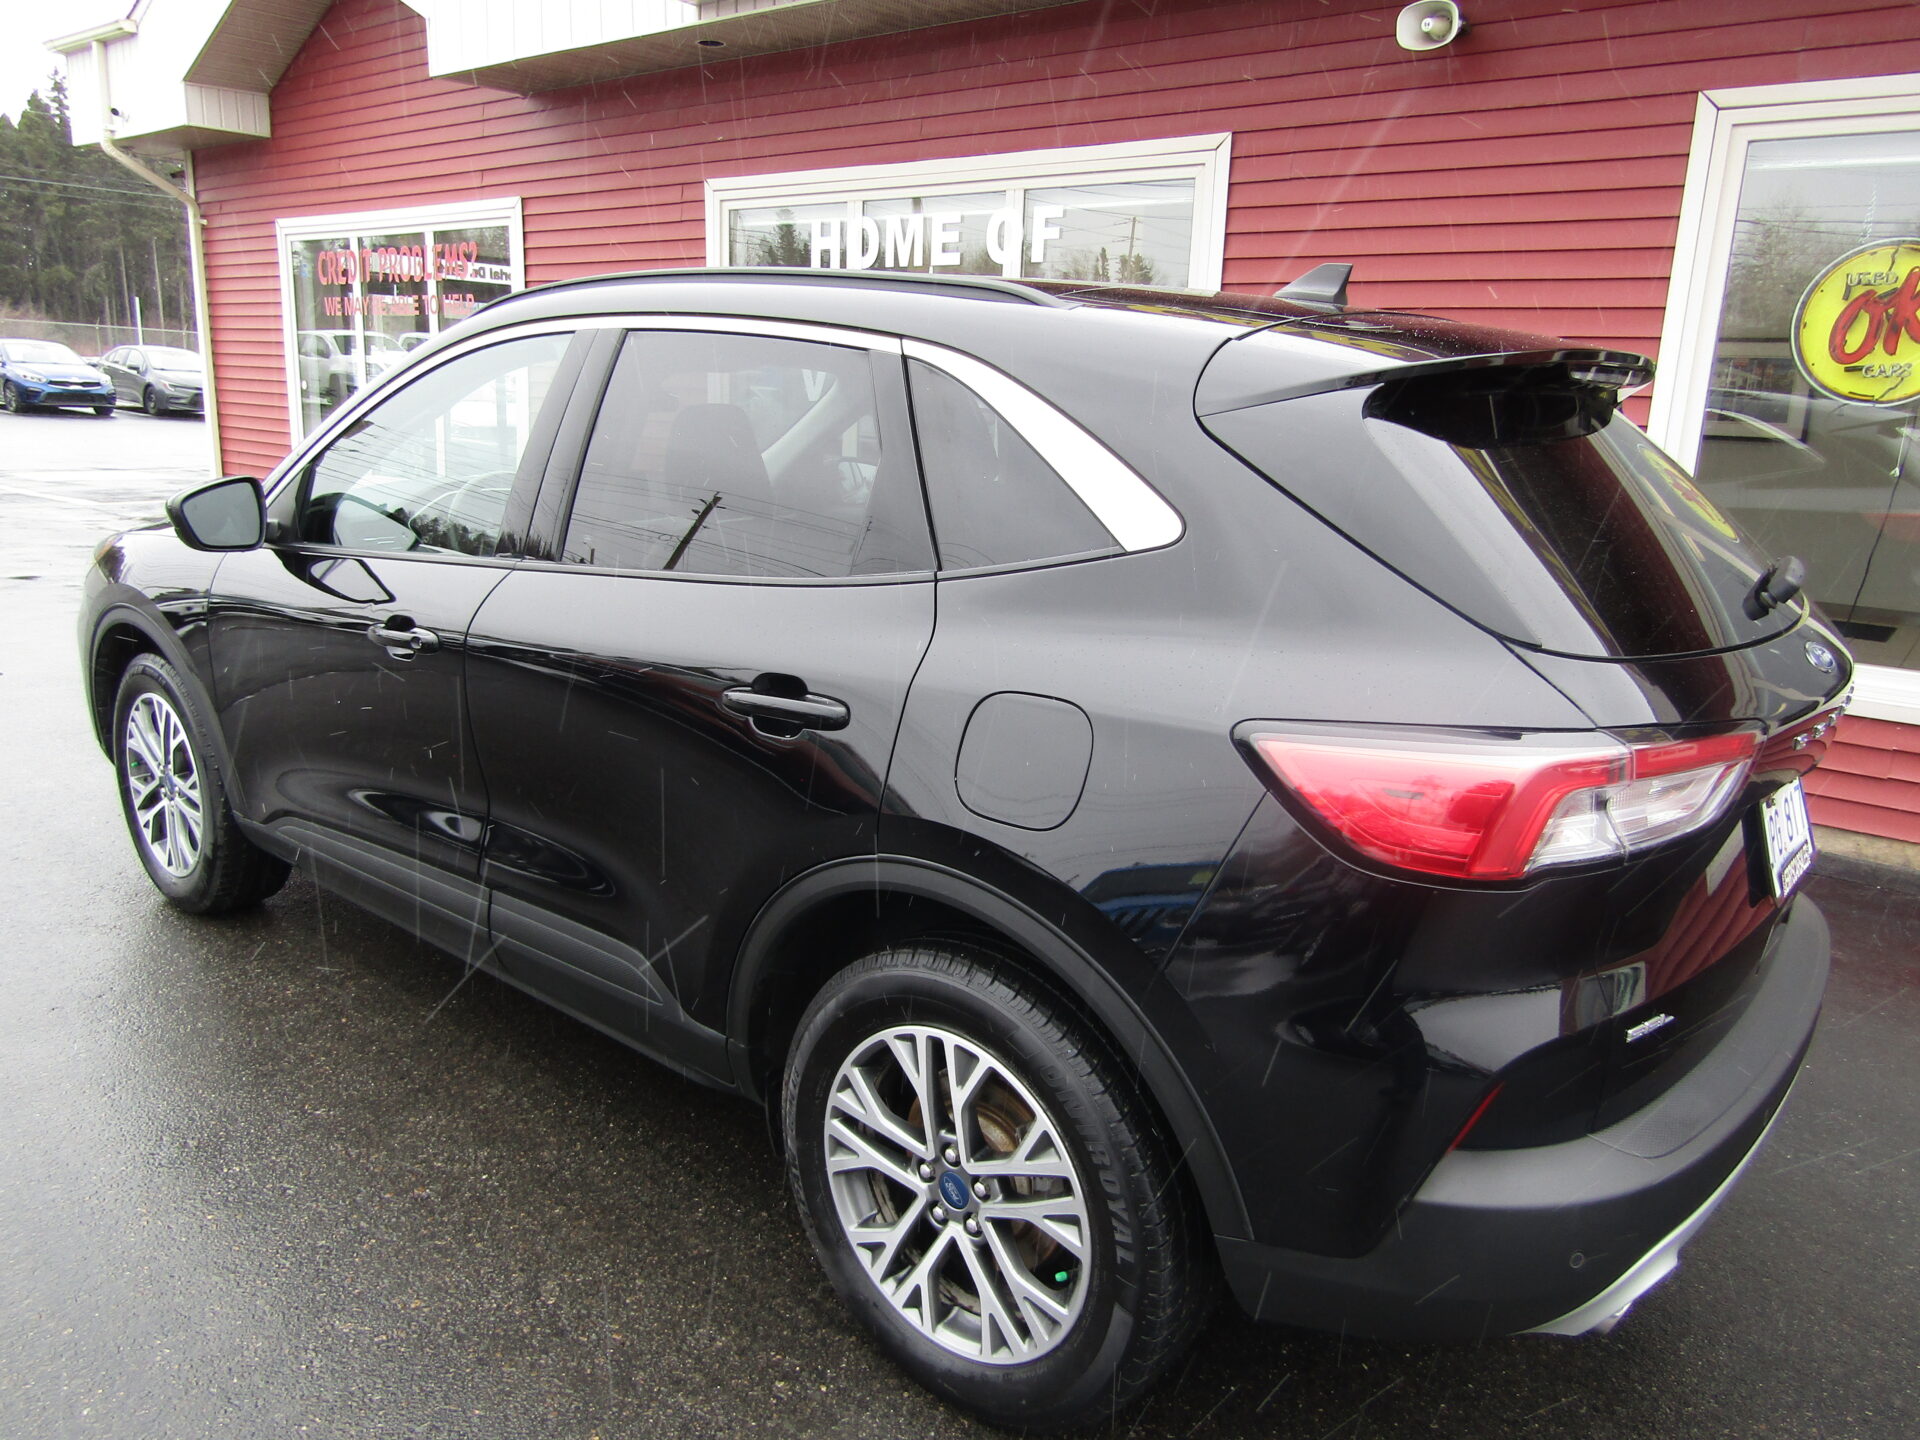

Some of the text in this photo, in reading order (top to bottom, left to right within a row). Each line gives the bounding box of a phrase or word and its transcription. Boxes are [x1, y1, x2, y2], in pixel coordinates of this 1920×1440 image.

[810, 204, 1063, 270] HOME OF
[318, 241, 478, 285] CREDIT PROBLEMS?
[1846, 270, 1899, 288] USED
[324, 296, 342, 316] WE
[344, 295, 369, 316] MAY
[422, 294, 439, 315] TO
[442, 293, 475, 316] HELP
[1829, 265, 1920, 365] OK
[1862, 362, 1913, 379] CARS
